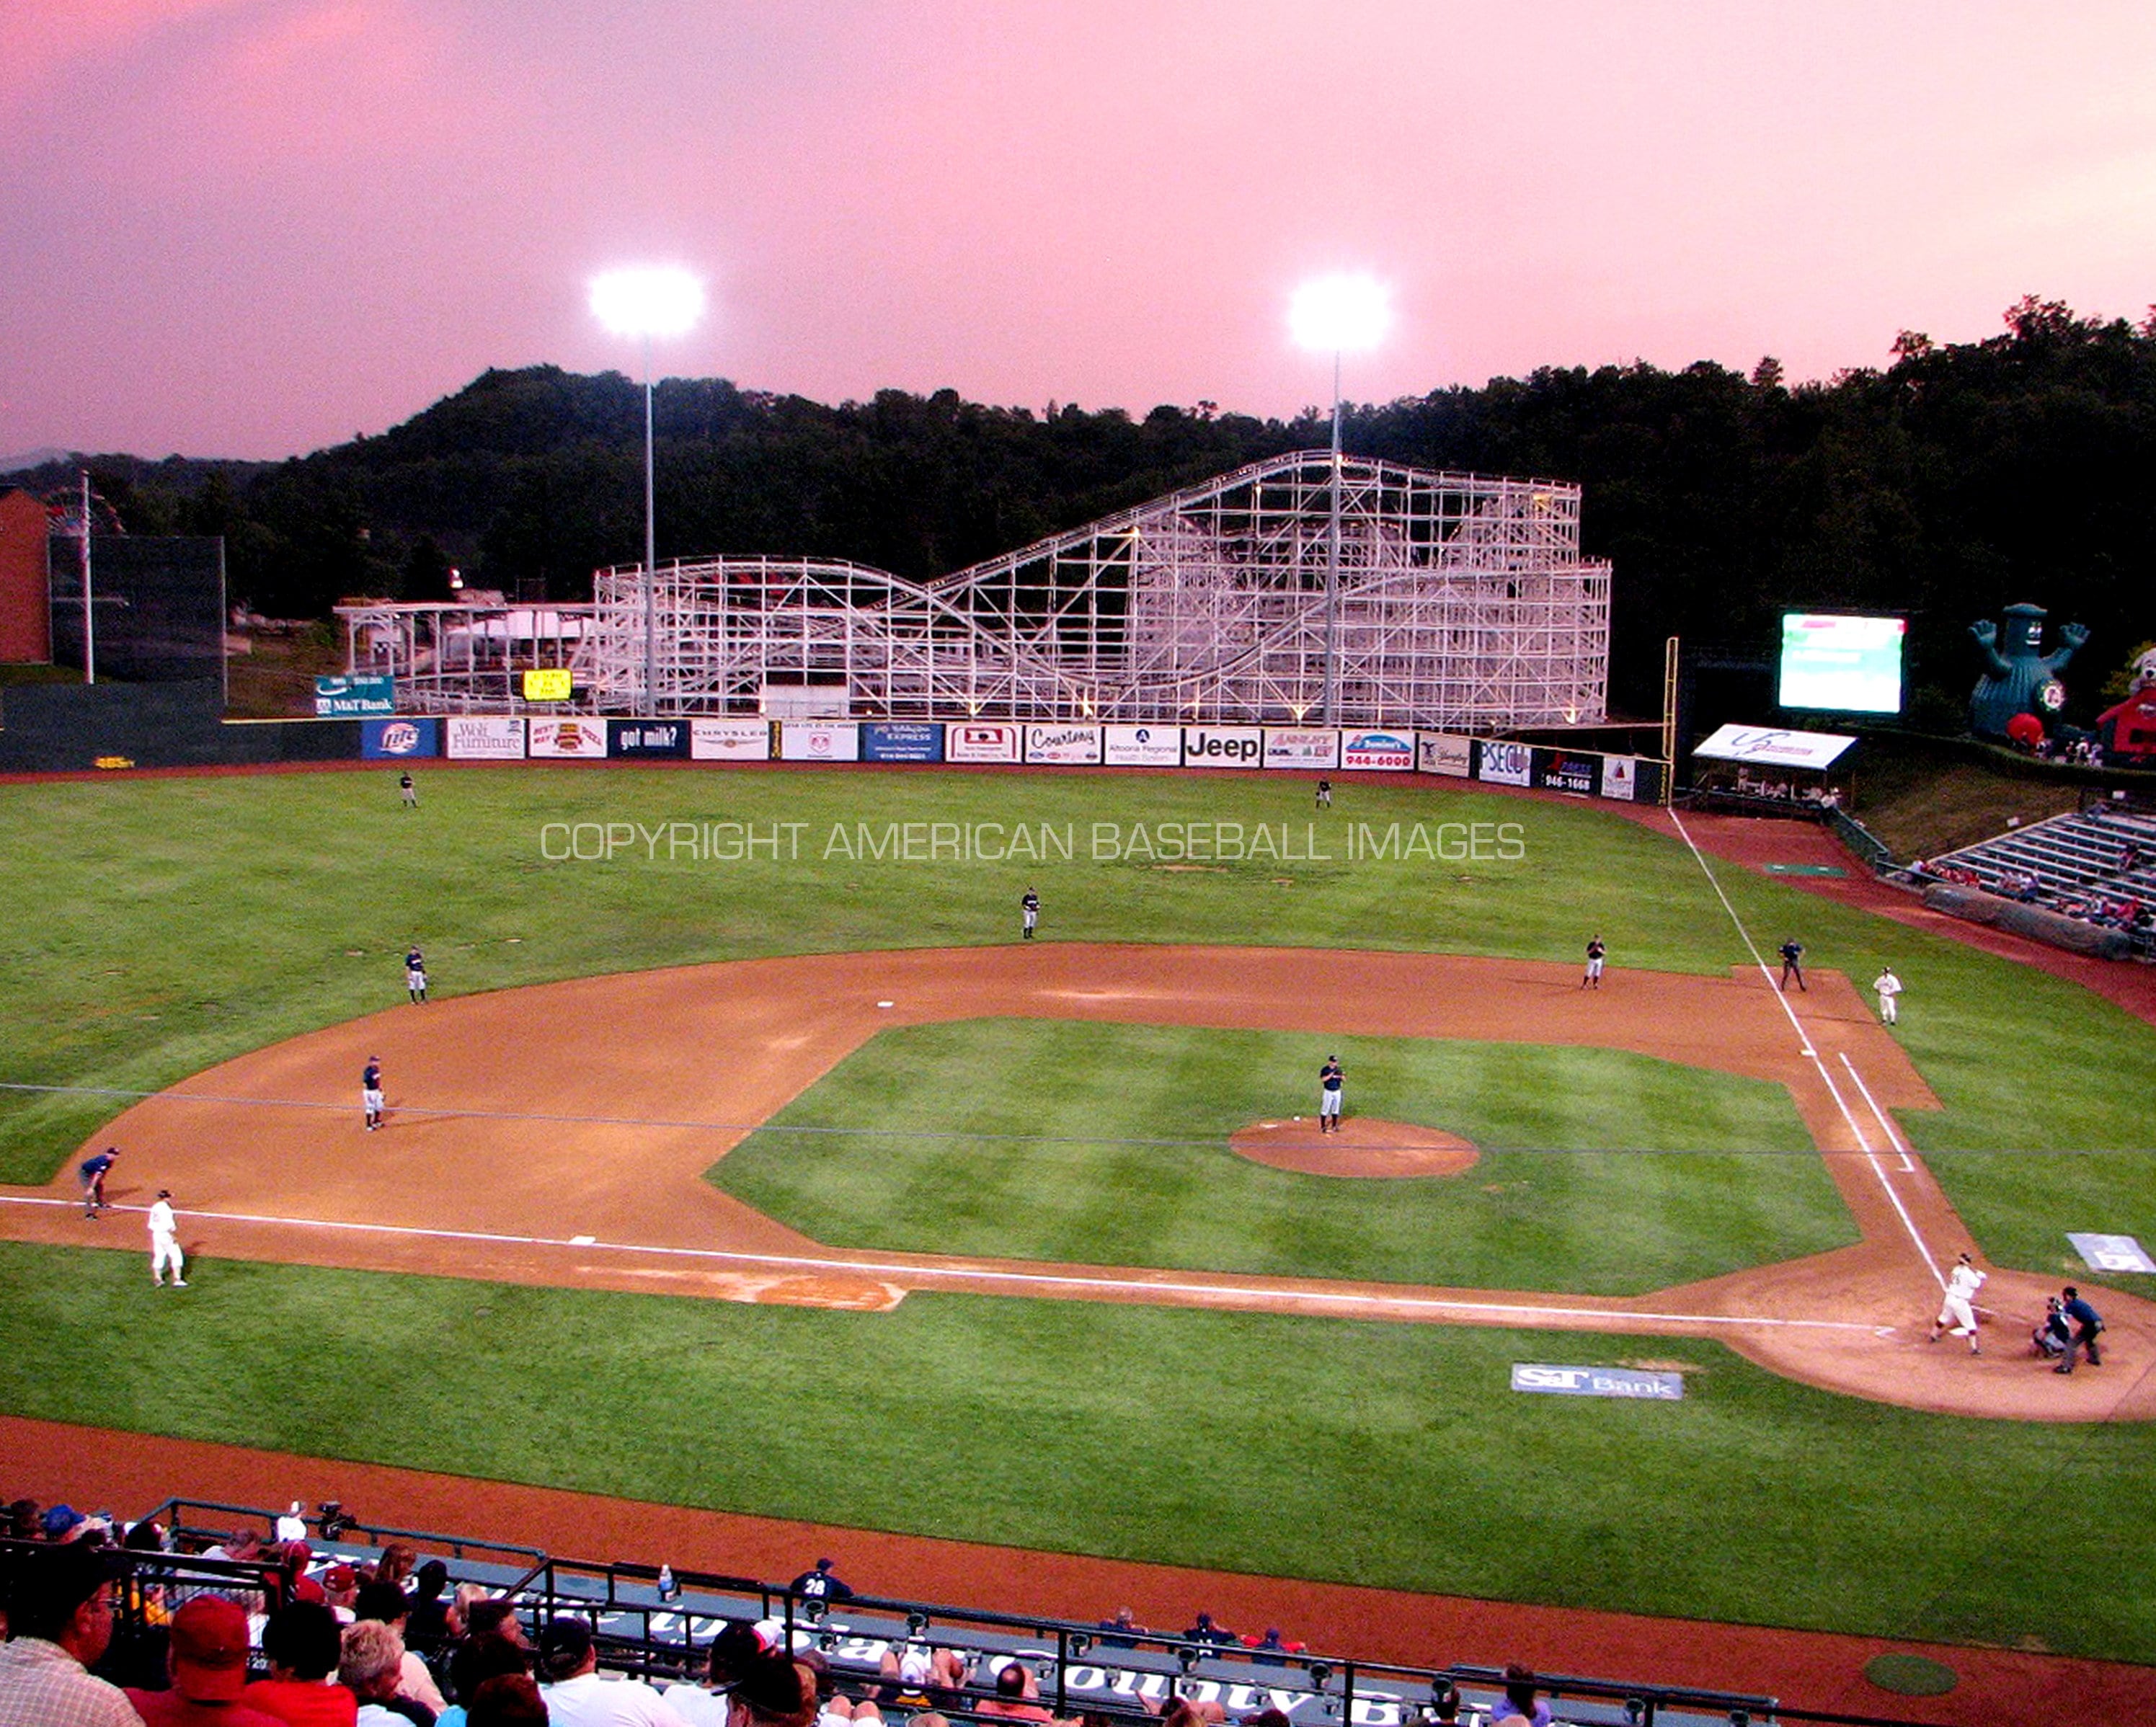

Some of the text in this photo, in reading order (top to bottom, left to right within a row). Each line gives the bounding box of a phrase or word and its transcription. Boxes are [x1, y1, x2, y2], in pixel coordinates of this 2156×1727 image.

[362, 698, 392, 710] Bank
[621, 725, 678, 750] got milk?
[1186, 732, 1258, 762] Jeep
[1346, 755, 1411, 766] 944-6000
[1480, 742, 1525, 774] PSECU
[1592, 1377, 1672, 1394] Bank
[804, 1578, 825, 1596] 28
